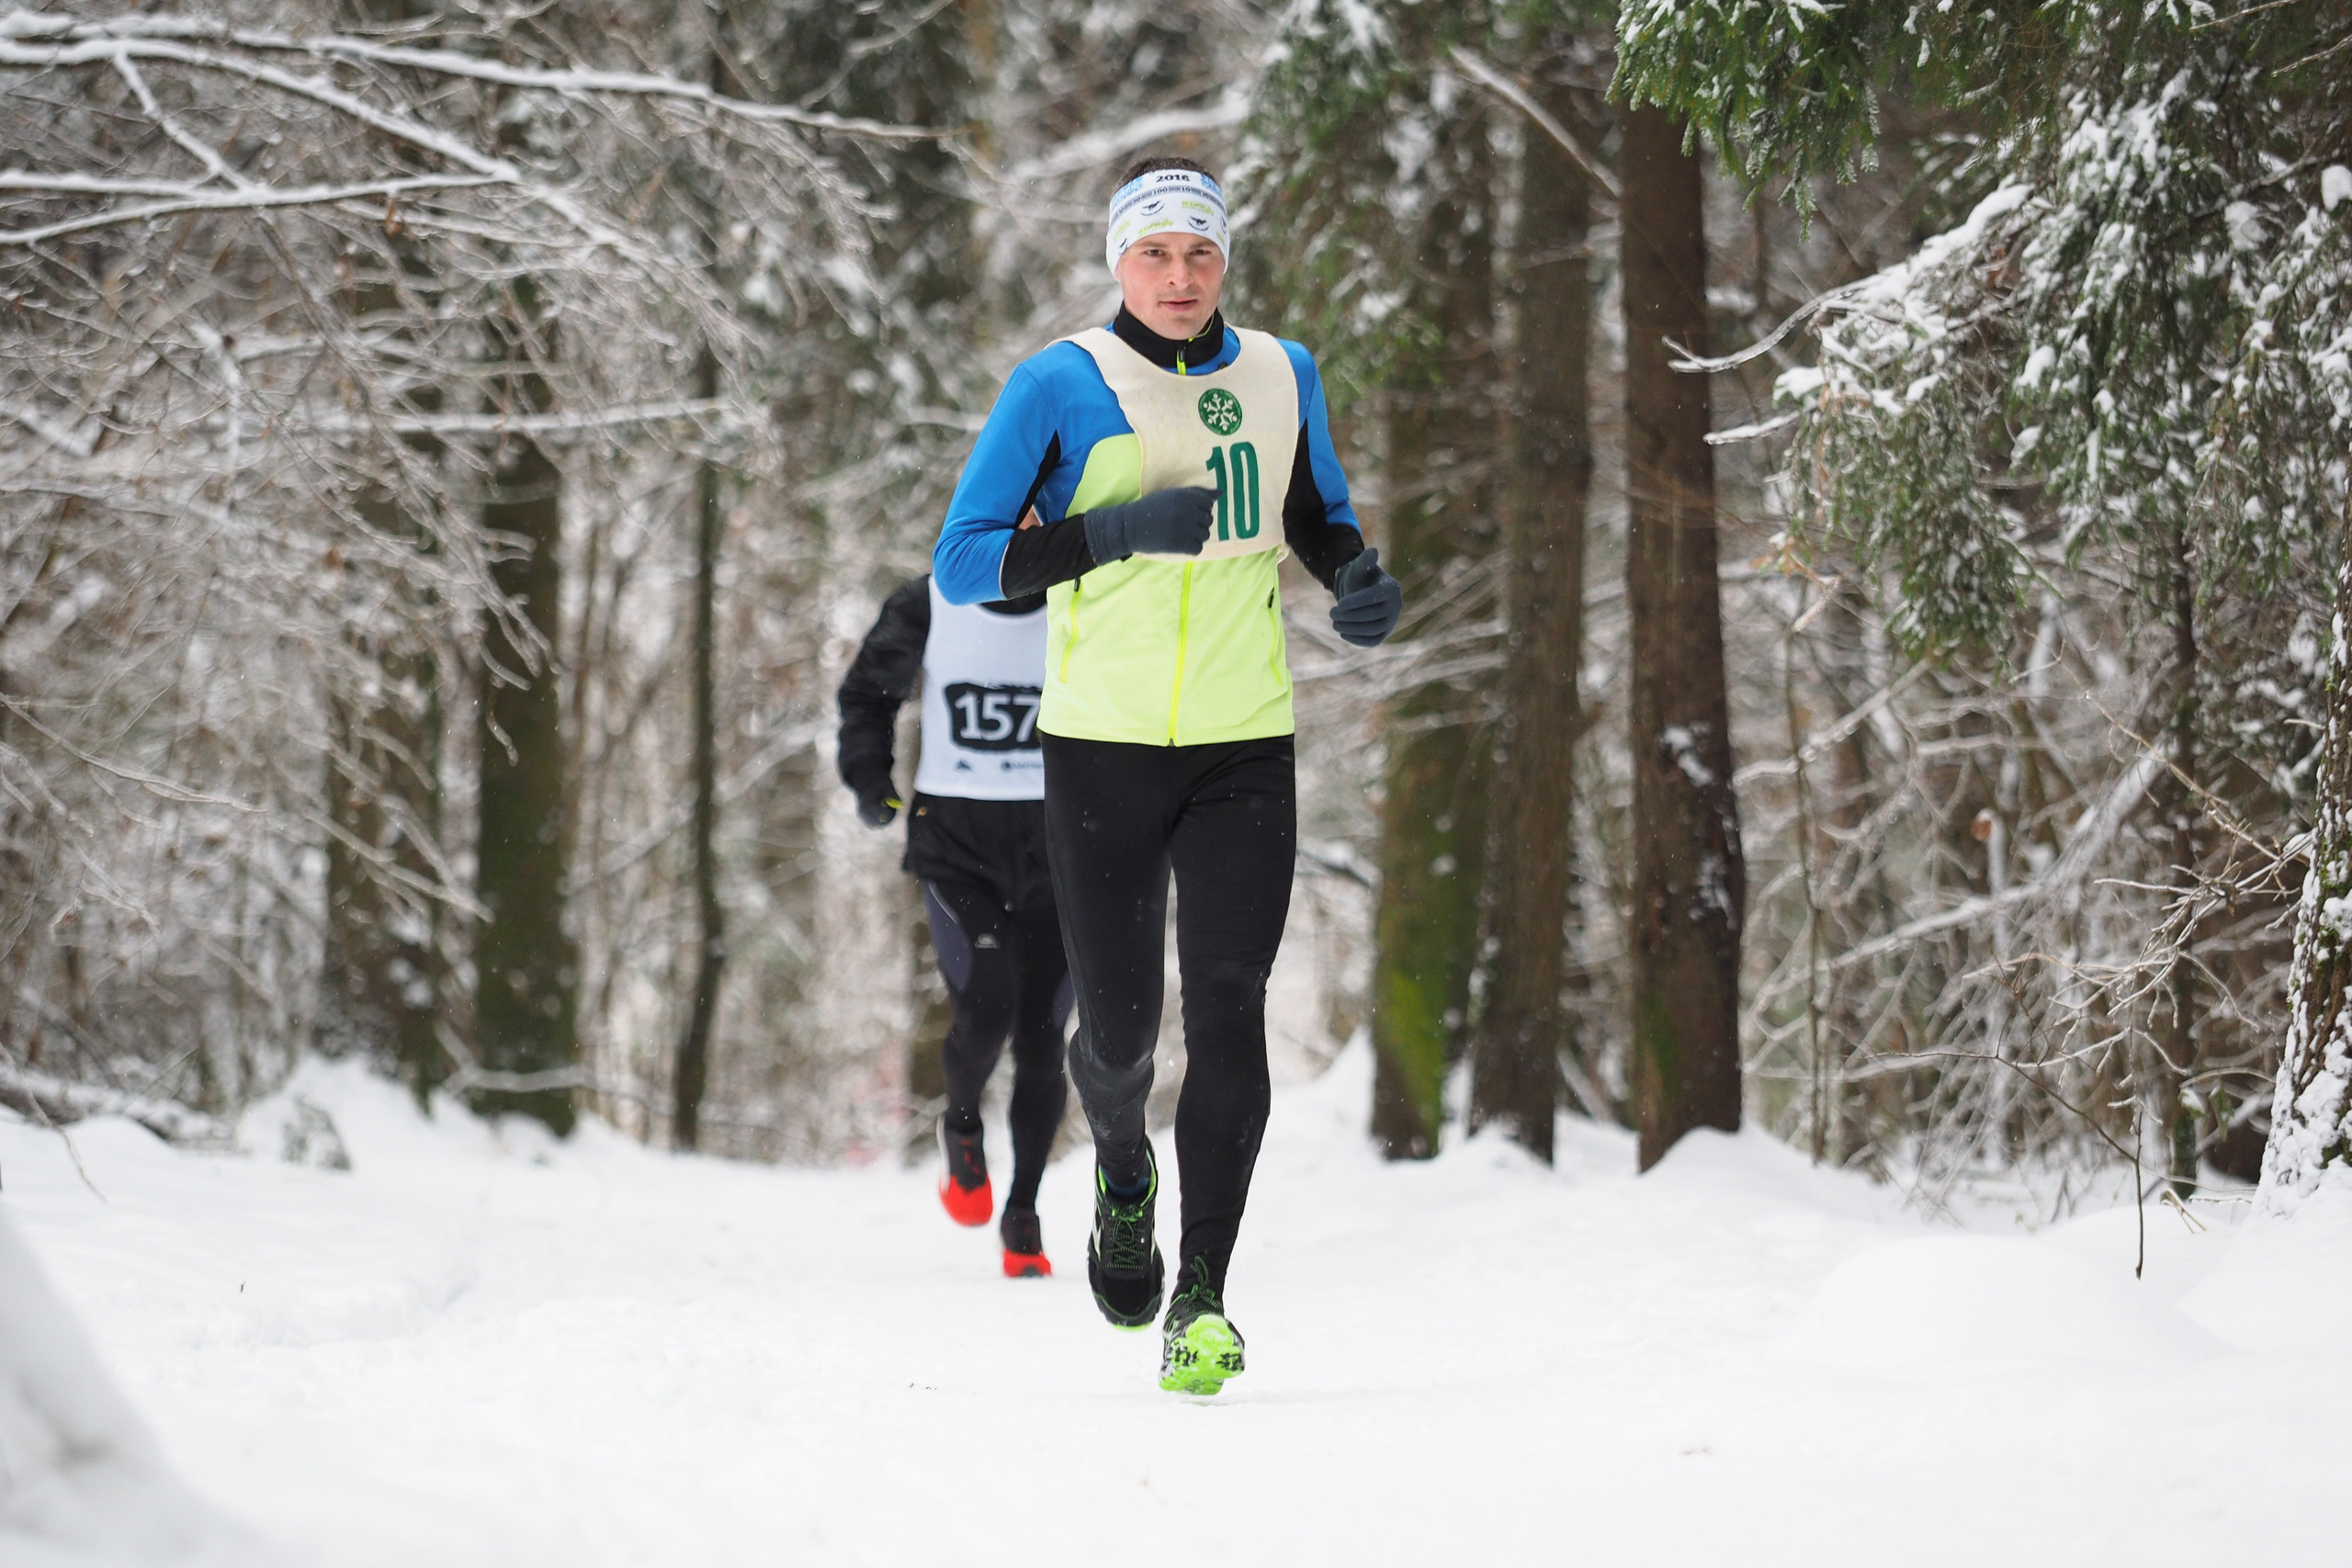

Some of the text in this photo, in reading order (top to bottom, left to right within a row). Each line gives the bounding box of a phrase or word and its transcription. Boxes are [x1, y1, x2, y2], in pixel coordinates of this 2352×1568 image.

[1156, 175, 1190, 183] 2016
[1205, 441, 1260, 541] 10
[954, 691, 1041, 743] 157
